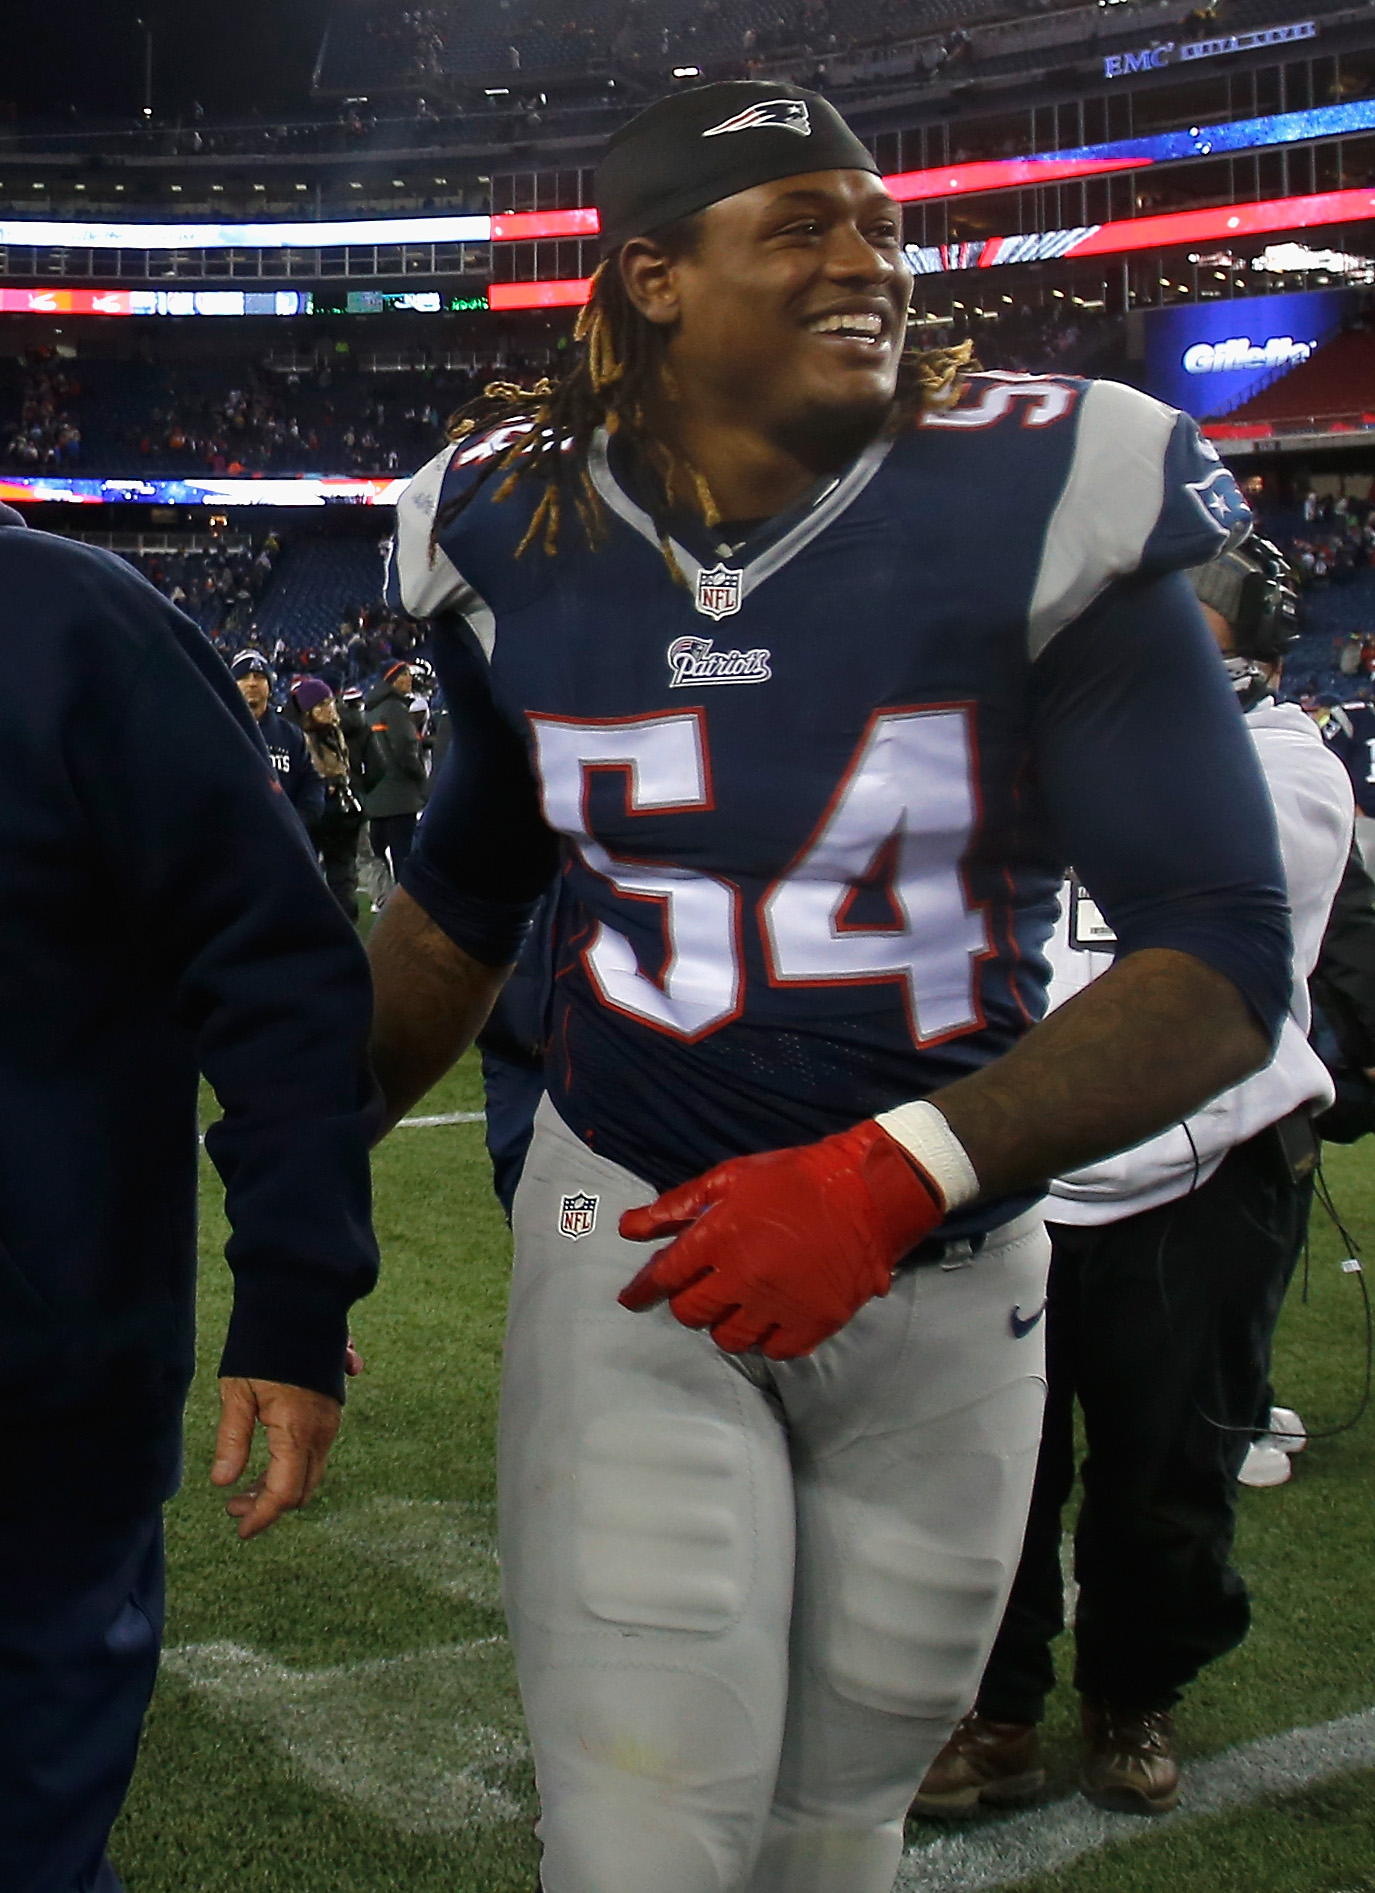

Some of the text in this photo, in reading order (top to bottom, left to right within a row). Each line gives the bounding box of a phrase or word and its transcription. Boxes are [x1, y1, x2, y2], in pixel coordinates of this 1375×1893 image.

[702, 588, 735, 611] NFL
[670, 649, 772, 687] Patriots
[524, 700, 998, 1050] 54
[563, 1211, 591, 1233] NFL
